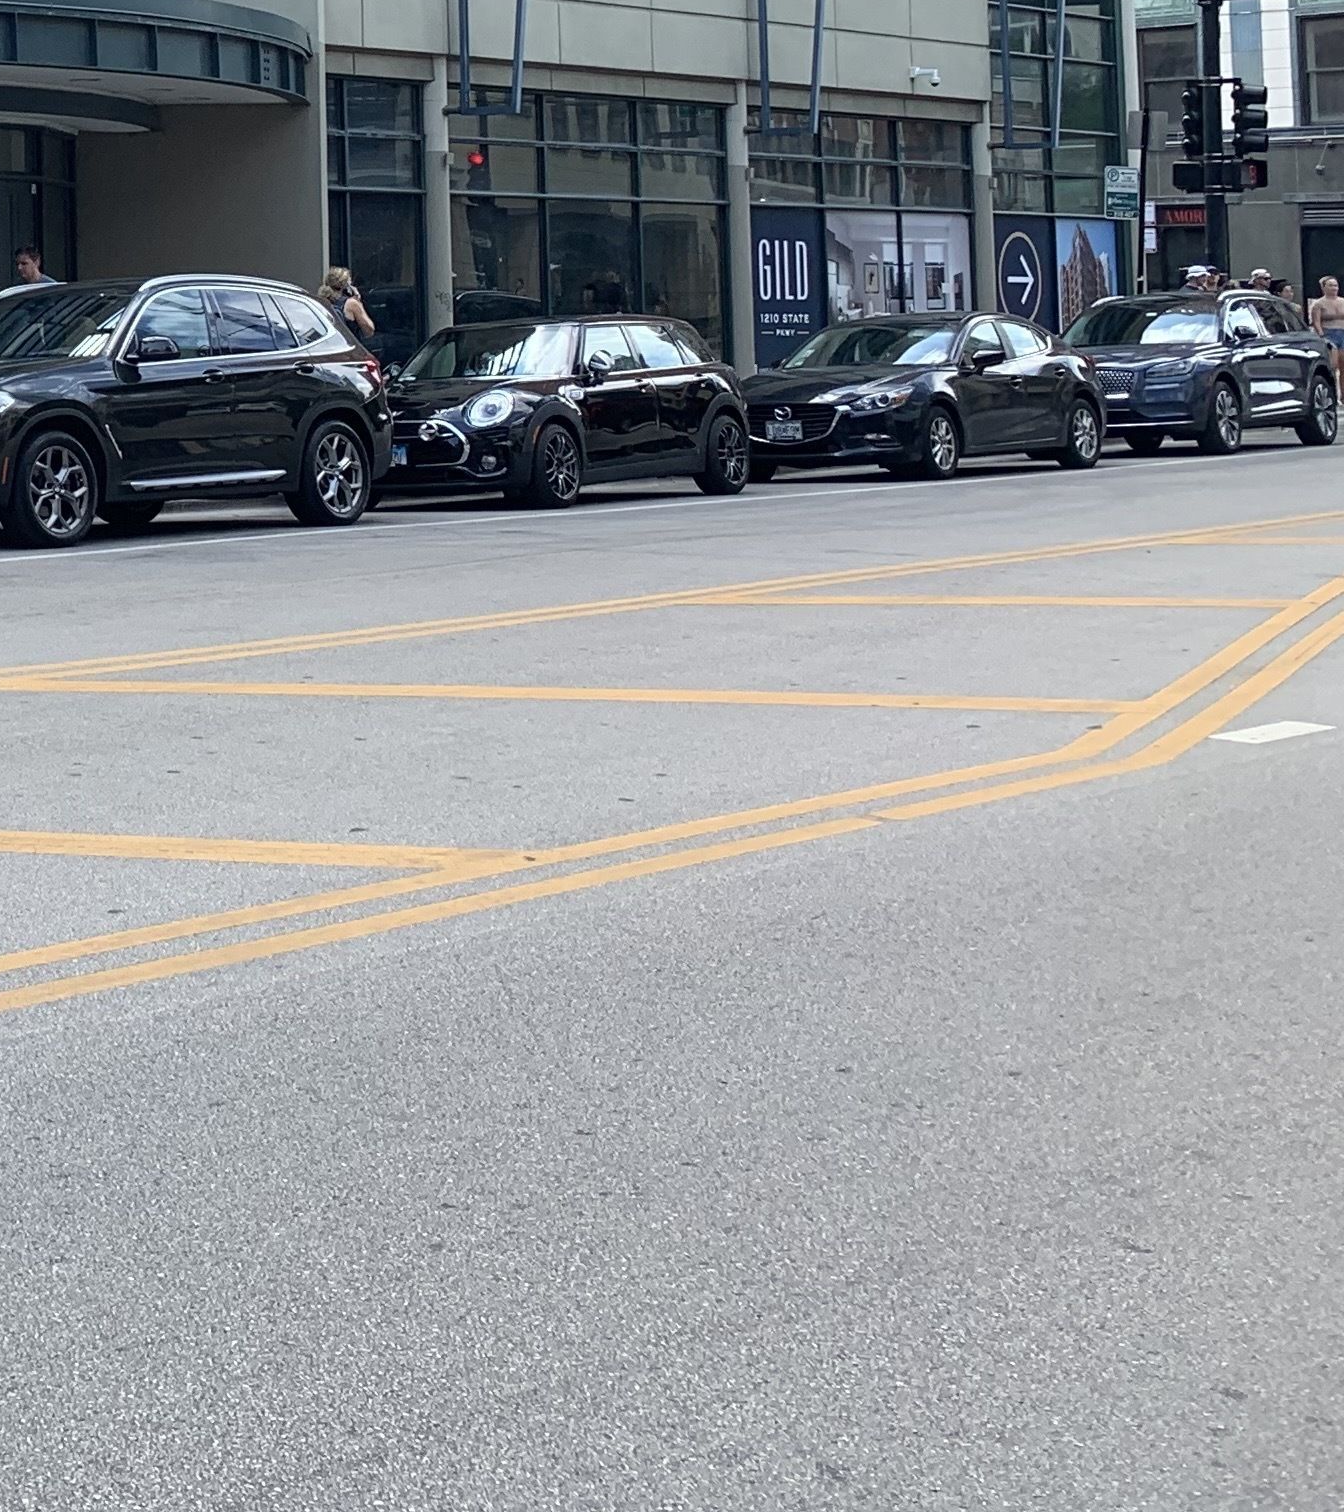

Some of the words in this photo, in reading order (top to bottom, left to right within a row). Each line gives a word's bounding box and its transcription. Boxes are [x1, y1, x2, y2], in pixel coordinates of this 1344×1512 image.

[1164, 209, 1207, 224] AMOR
[758, 239, 809, 300] GILD
[760, 313, 779, 324] 1210
[782, 313, 810, 324] STATE
[775, 329, 796, 337] PKWY
